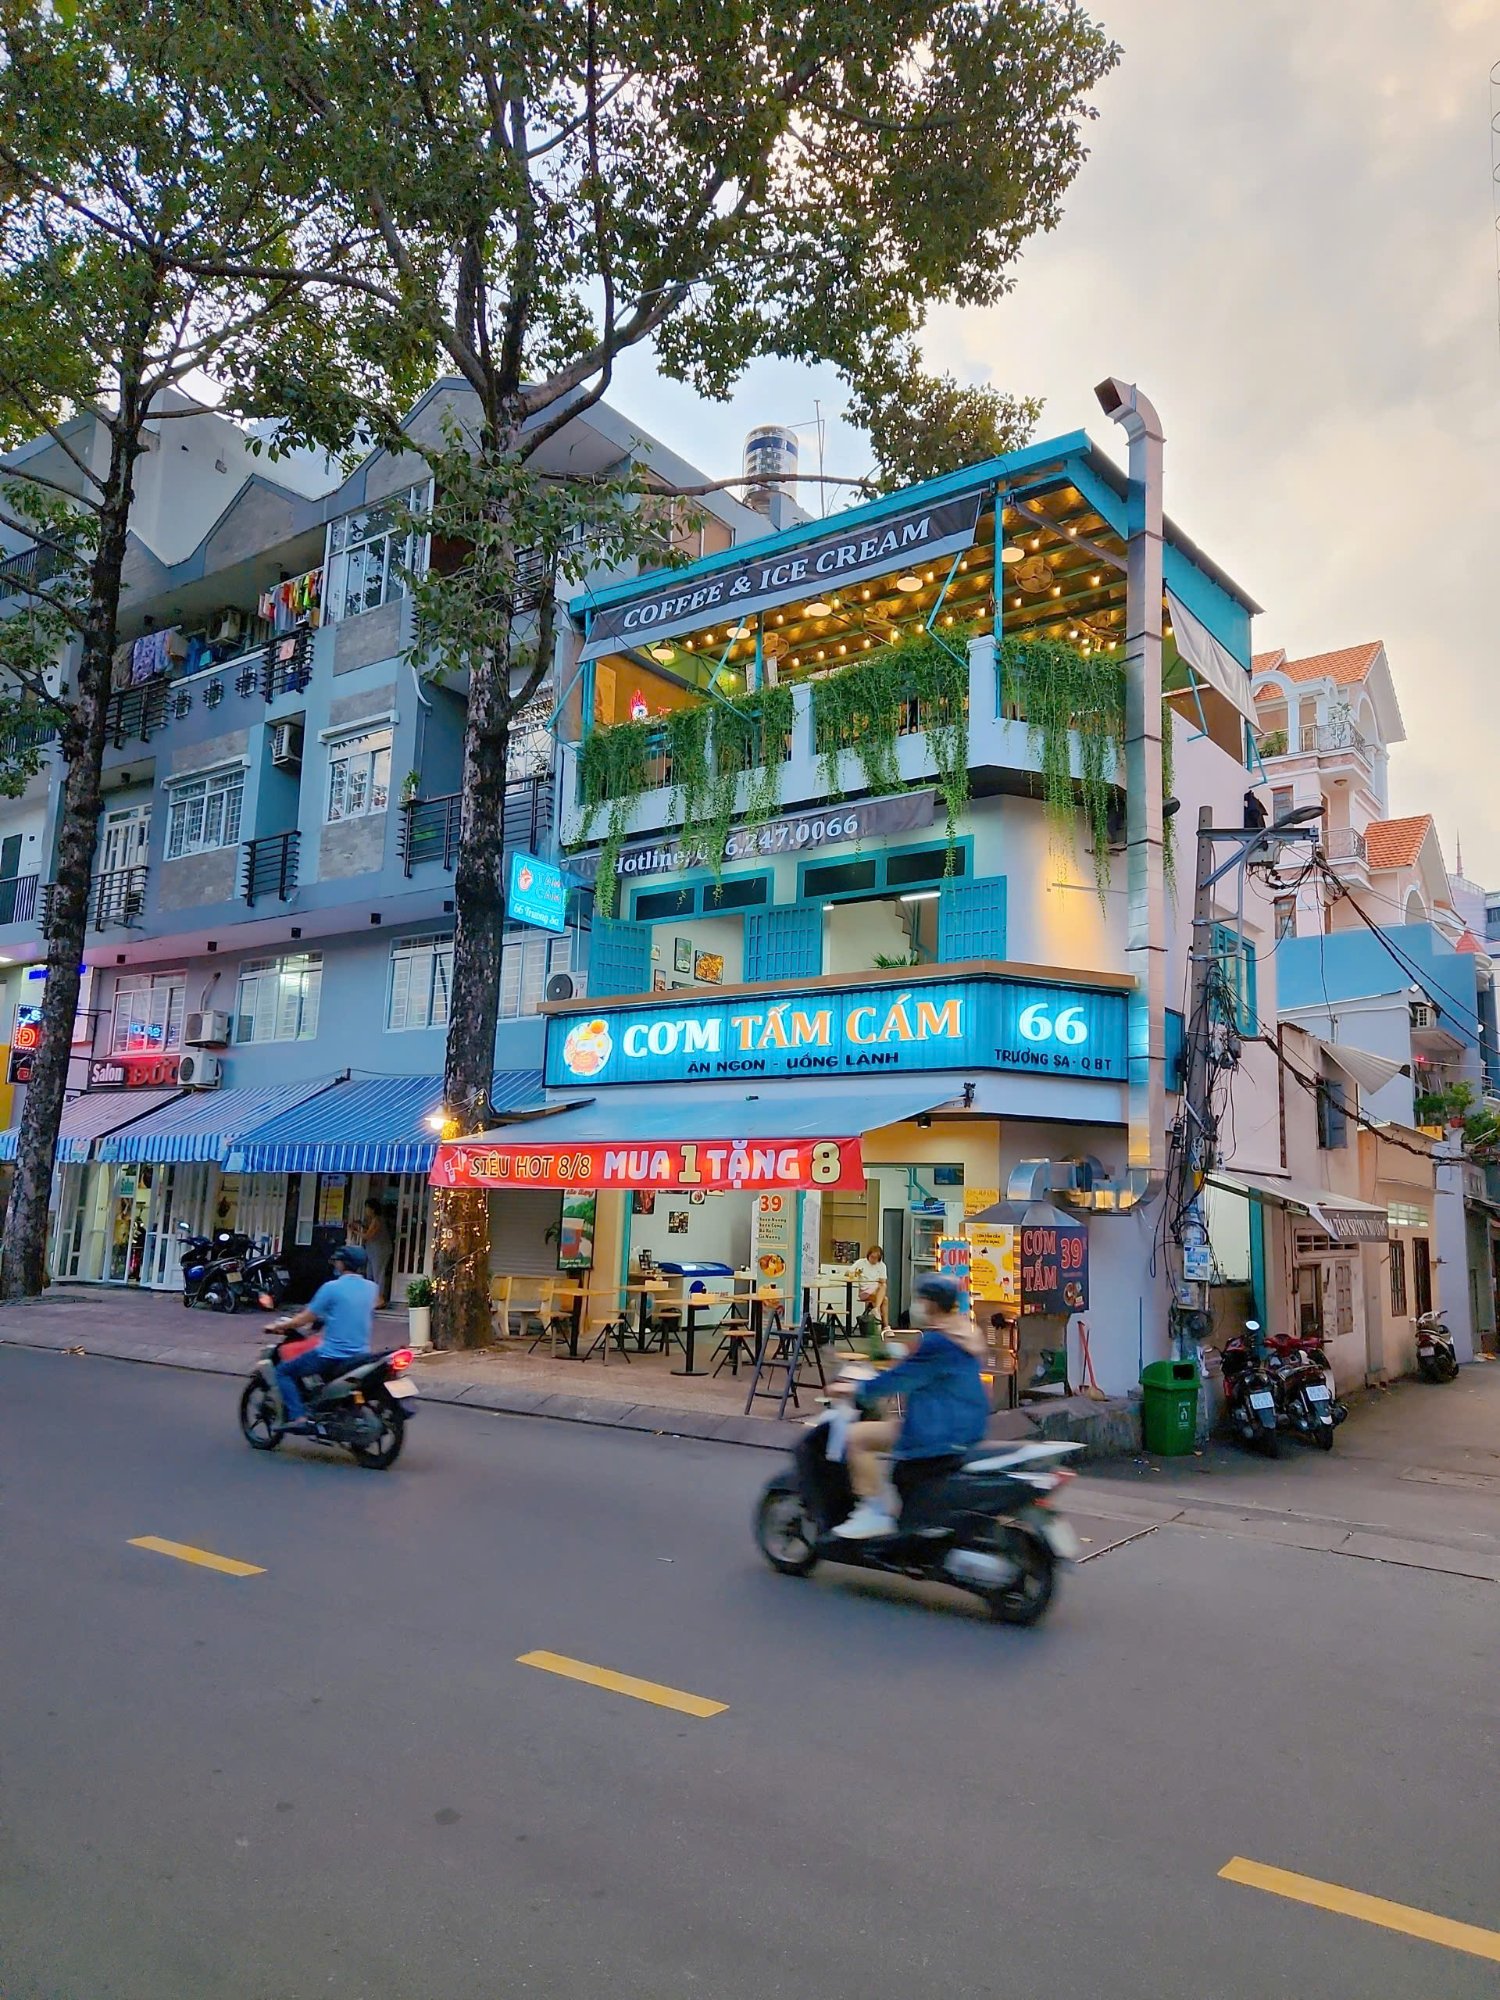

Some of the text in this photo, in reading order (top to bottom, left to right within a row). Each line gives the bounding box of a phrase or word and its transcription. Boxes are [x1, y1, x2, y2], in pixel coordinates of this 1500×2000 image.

[623, 516, 932, 629] COFFEE & ICE CREAM
[622, 993, 965, 1058] CƠM TẤM CÁM
[1018, 1002, 1089, 1046] 66
[91, 1063, 125, 1083] Salon
[687, 1058, 711, 1074] ĂN
[716, 1058, 766, 1073] NGON
[786, 1053, 839, 1070] UỐNG
[845, 1051, 899, 1067] LÀNH
[1053, 1054, 1070, 1068] SA
[469, 1139, 842, 1189] SIÊU HOT 8/8 MUA 1 TẶNG 8
[759, 1194, 784, 1213] 39
[1023, 1227, 1057, 1256] CƠM
[1061, 1237, 1083, 1269] 39
[1023, 1256, 1058, 1292] TẤM
